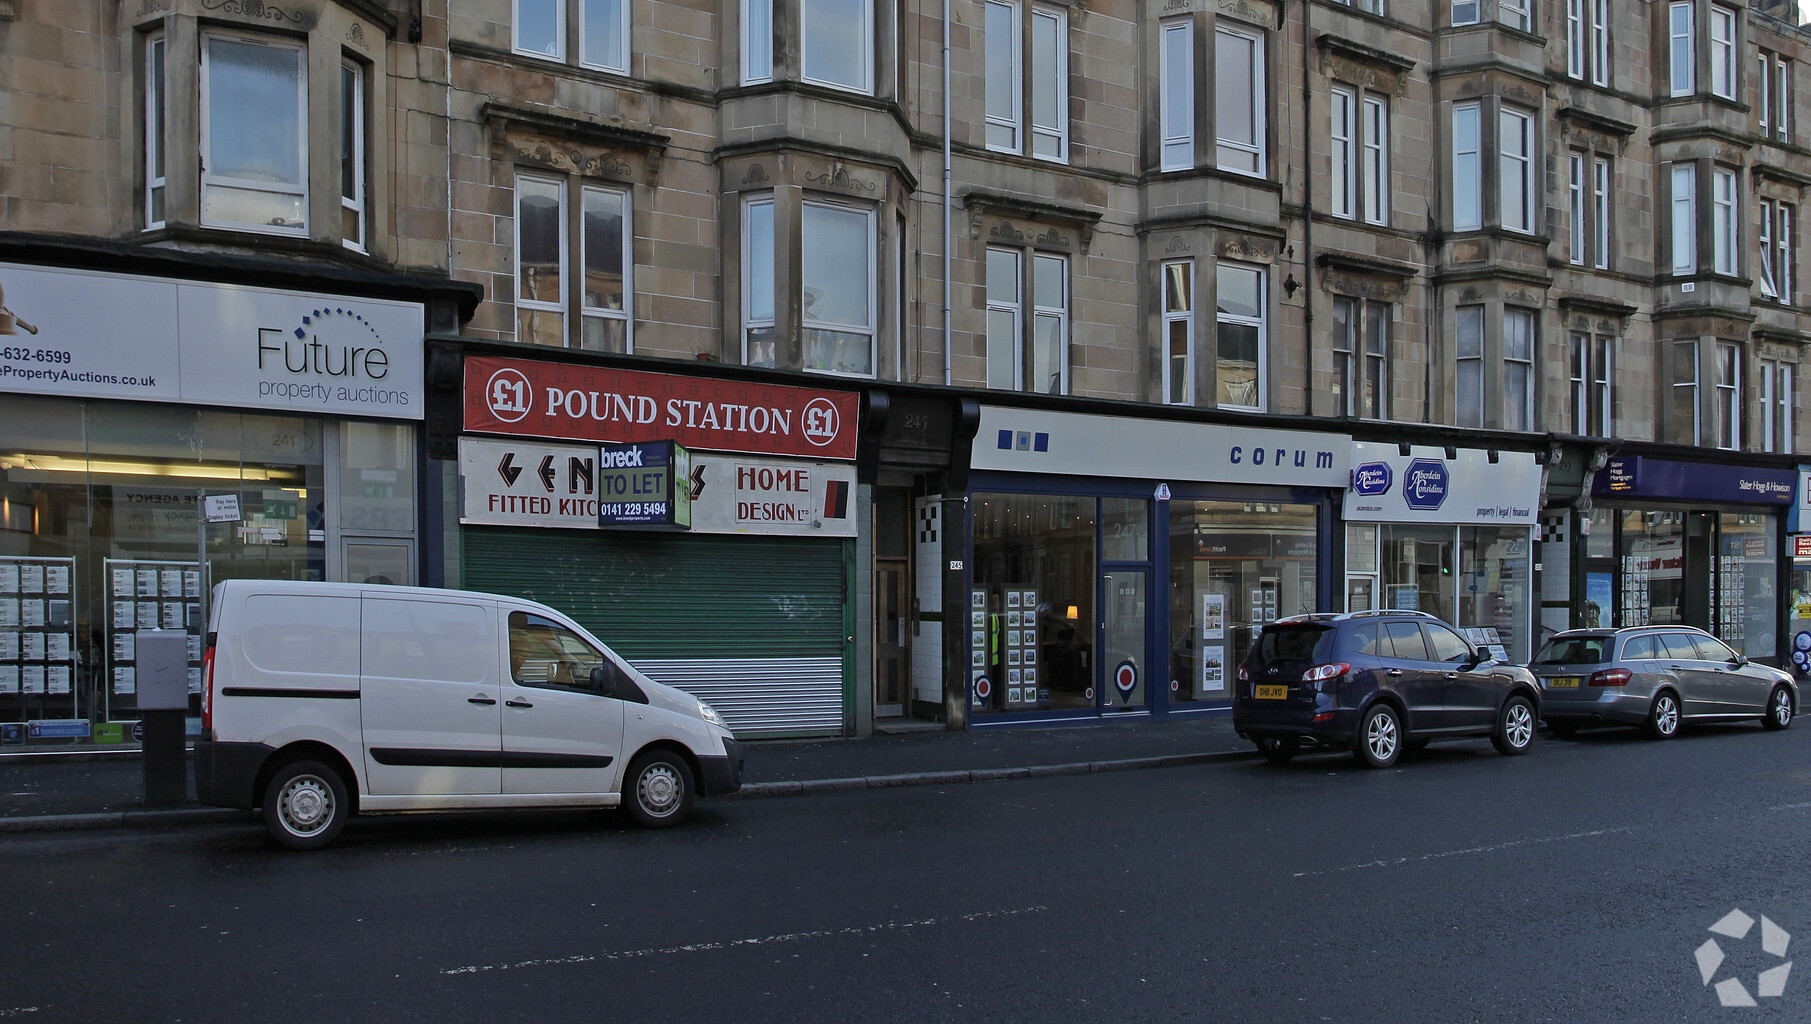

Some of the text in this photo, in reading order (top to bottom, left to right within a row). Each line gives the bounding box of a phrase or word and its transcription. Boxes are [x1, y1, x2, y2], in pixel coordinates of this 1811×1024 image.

[258, 328, 389, 379] Future
[259, 381, 409, 406] property auctions
[492, 379, 835, 438] £1 POUND STATION £1
[601, 445, 643, 468] breck
[1230, 445, 1334, 469] corum
[604, 473, 663, 495] TO LET
[737, 467, 809, 492] HOME
[1357, 470, 1383, 485] Aberdein
[1408, 470, 1441, 490] Aberdein
[1739, 479, 1790, 494] Slater Hogg & Howison
[1415, 479, 1444, 499] Considine
[488, 494, 599, 517] FITTED KITC
[601, 502, 666, 516] 0141 229 5494
[737, 502, 795, 521] DESIGN
[1476, 507, 1495, 518] property
[1498, 507, 1509, 518] legal
